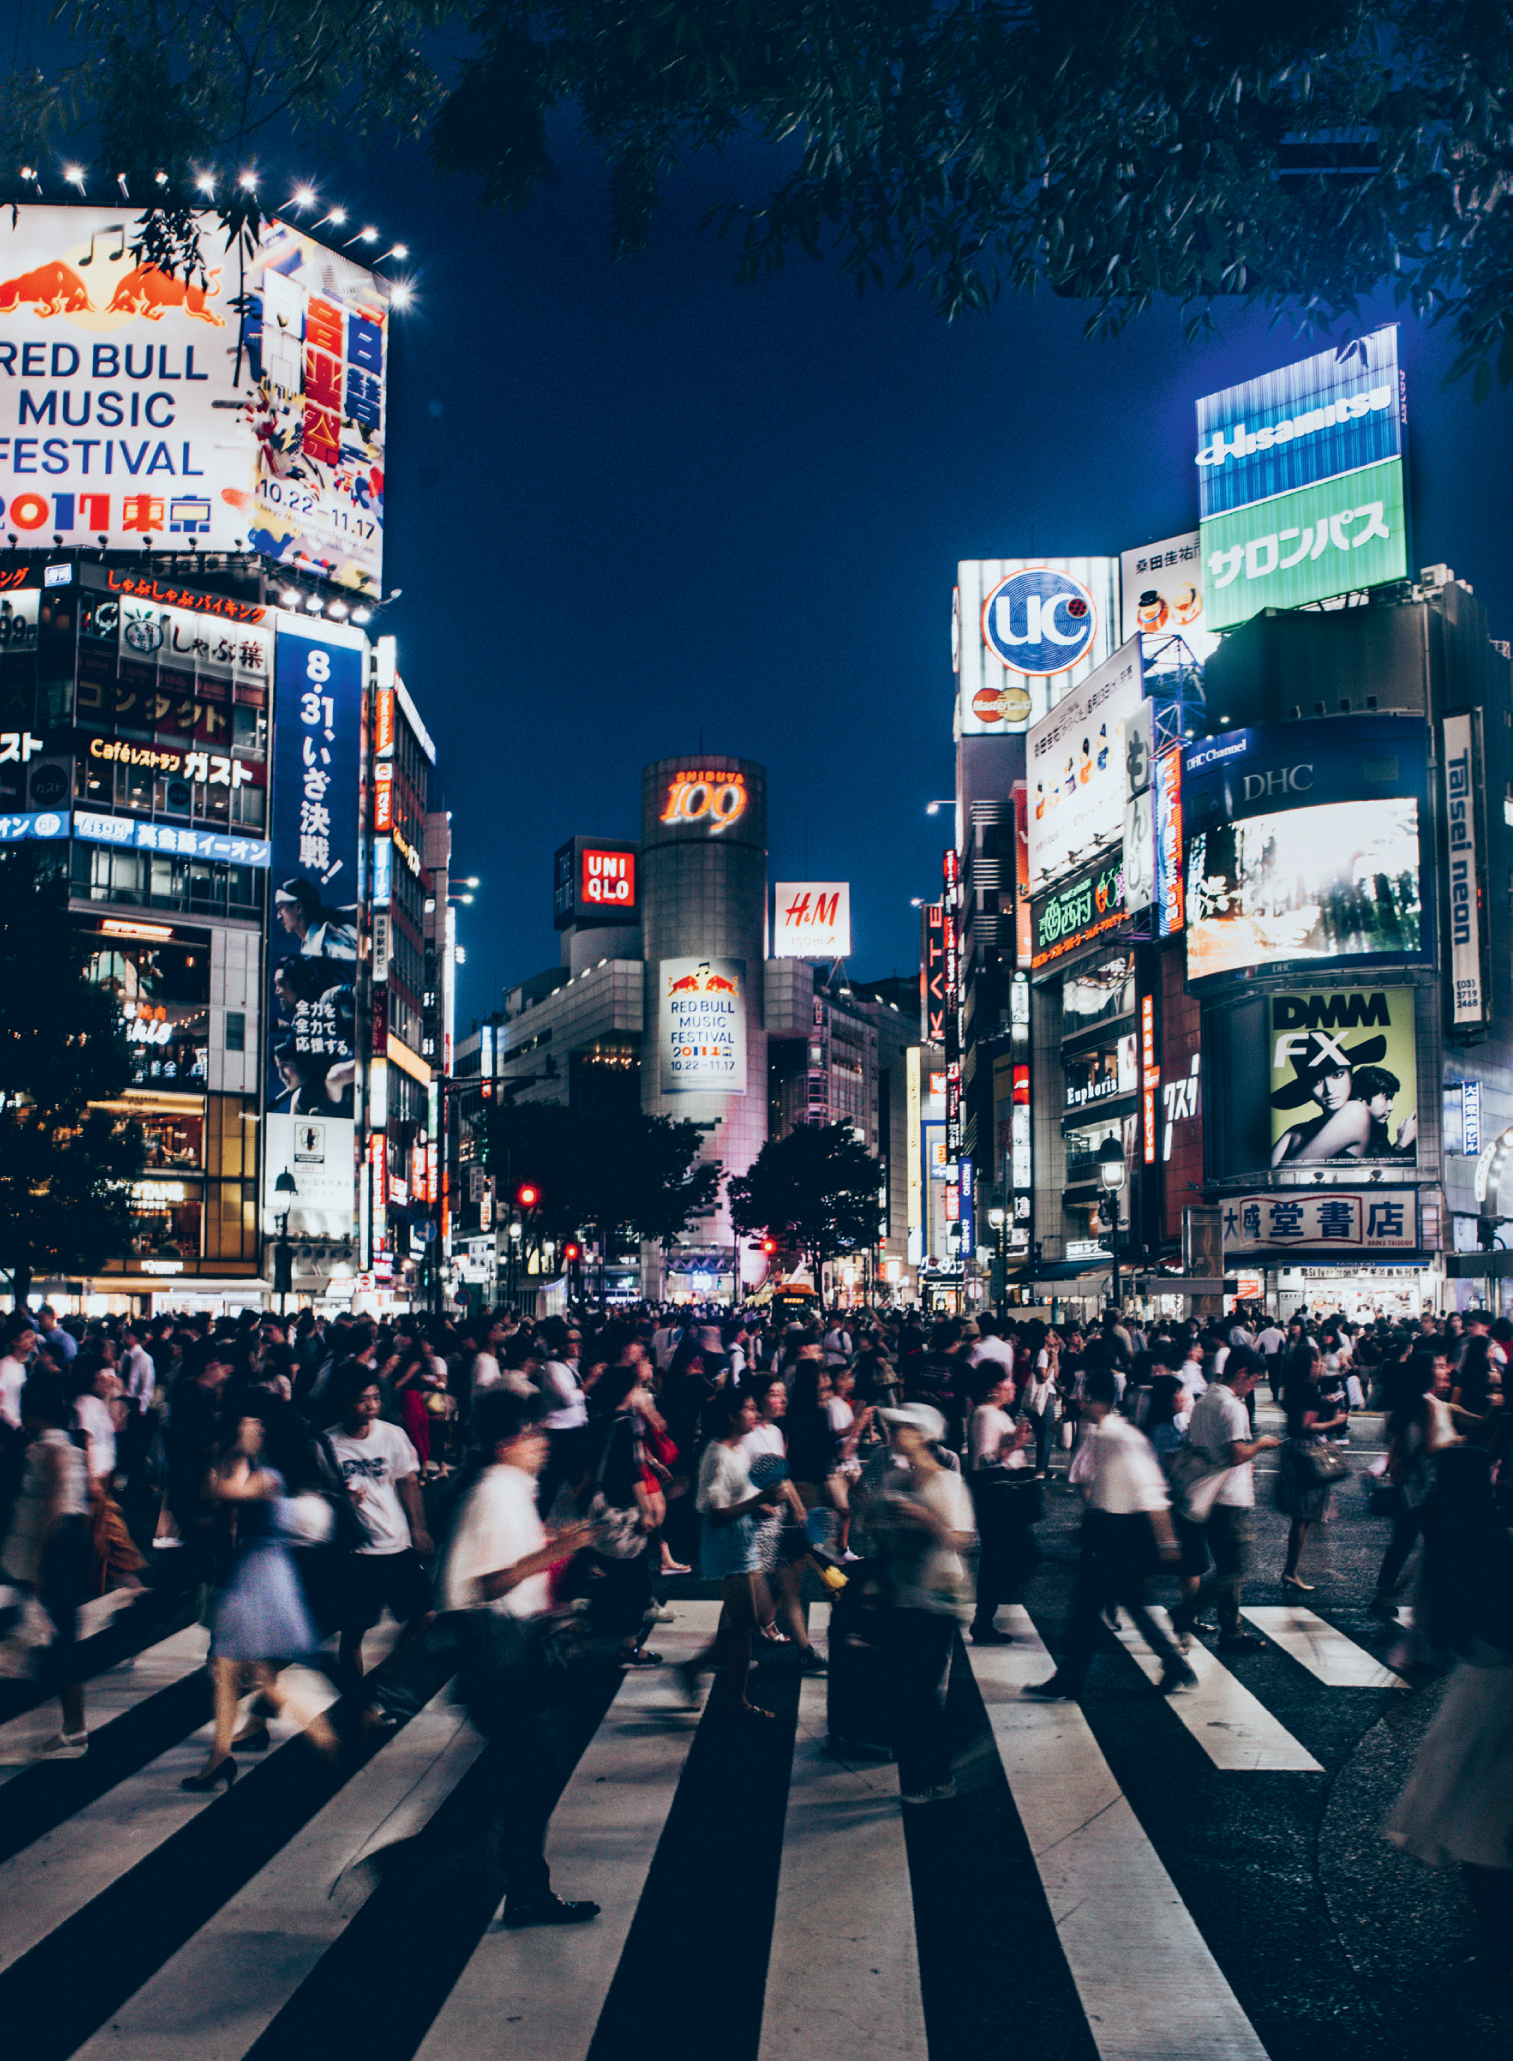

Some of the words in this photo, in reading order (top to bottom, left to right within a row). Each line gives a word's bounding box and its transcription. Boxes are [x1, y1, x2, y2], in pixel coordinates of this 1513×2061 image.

[92, 343, 209, 380] BULL
[19, 389, 176, 428] MUSIC
[1195, 385, 1391, 466] Hisamitsu
[0, 492, 111, 531] 017
[122, 493, 211, 532] 東京
[260, 479, 313, 516] 10.22
[332, 509, 375, 539] 11.17
[1208, 501, 1389, 589] サロンパス
[107, 569, 266, 623] しゃぶしゃぶバイキング
[173, 625, 263, 669] しゃぶ葉
[973, 700, 1031, 711] MasterCard
[184, 752, 253, 788] ガスト
[1186, 752, 1206, 771] DHC
[1206, 738, 1247, 764] Channel
[676, 771, 744, 784] SHIBUYA
[1243, 764, 1314, 801] DHC
[660, 781, 747, 833] 109
[1447, 748, 1472, 852] Taisei
[80, 817, 127, 840] AEON
[138, 824, 267, 860] 英会話イーオン
[588, 856, 625, 878] UNI
[588, 878, 629, 901] QLO
[1452, 860, 1470, 945] neon
[785, 892, 839, 927] H&M
[929, 906, 943, 1038] KATE
[1272, 962, 1293, 974] DHC
[1456, 979, 1475, 990] (03)
[296, 1000, 336, 1018] 全力を
[671, 1001, 697, 1013] RED
[700, 1001, 735, 1013] BULL
[1273, 993, 1391, 1030] DMM
[1456, 989, 1477, 999] 3719
[1456, 999, 1478, 1009] 2468
[296, 1018, 336, 1035] 全力で
[671, 1032, 734, 1043] FESTIVAL
[680, 1017, 726, 1028] MUSIC
[296, 1036, 353, 1056] 応援する。
[1273, 1031, 1351, 1068] FX
[671, 1061, 699, 1071] 10.22
[711, 1061, 734, 1071] 11.17
[1066, 1077, 1117, 1105] Euphoria
[962, 1163, 971, 1197] MIZUHO
[1224, 1201, 1404, 1240] 大盛堂書店
